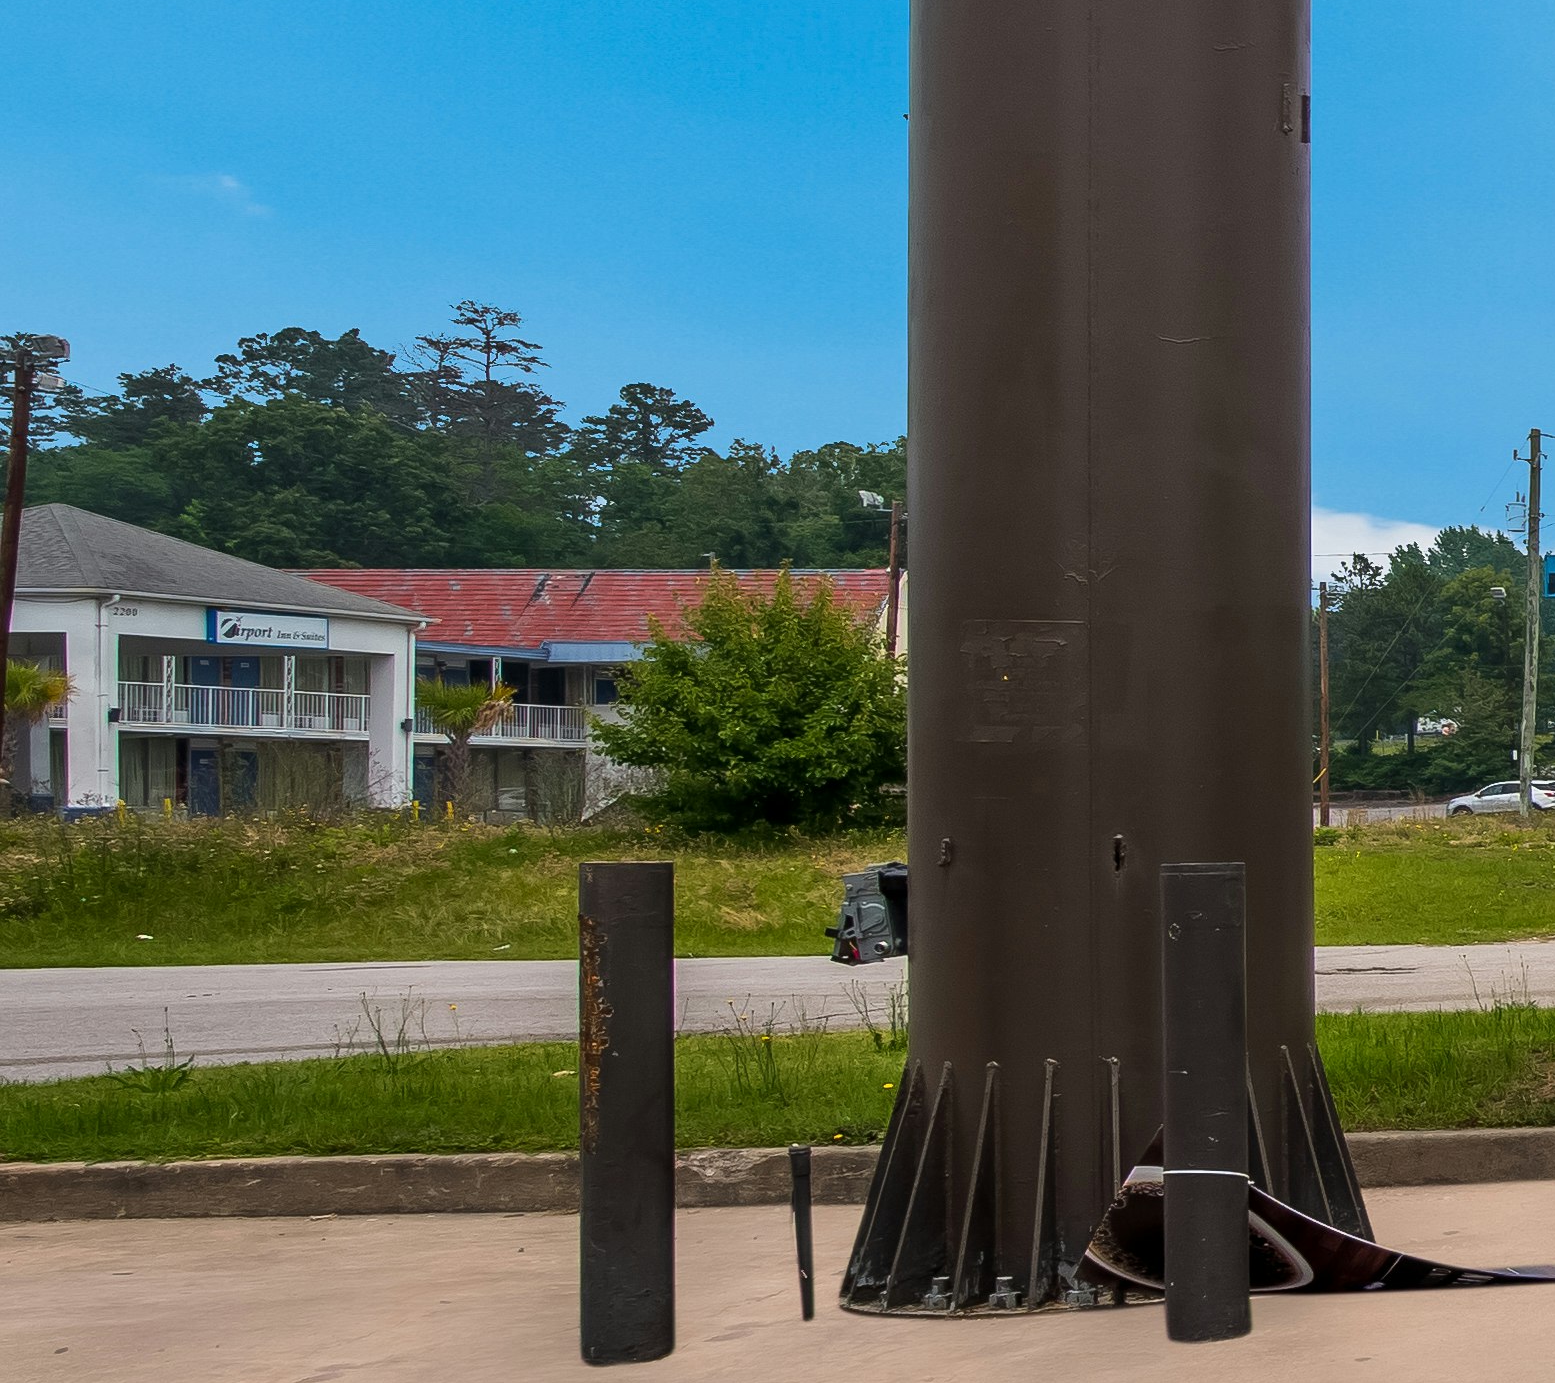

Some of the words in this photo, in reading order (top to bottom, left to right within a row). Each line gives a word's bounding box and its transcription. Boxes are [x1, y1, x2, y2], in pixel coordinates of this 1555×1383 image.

[220, 618, 273, 642] Airport
[276, 629, 292, 640] Inn
[300, 631, 326, 642] Suites
